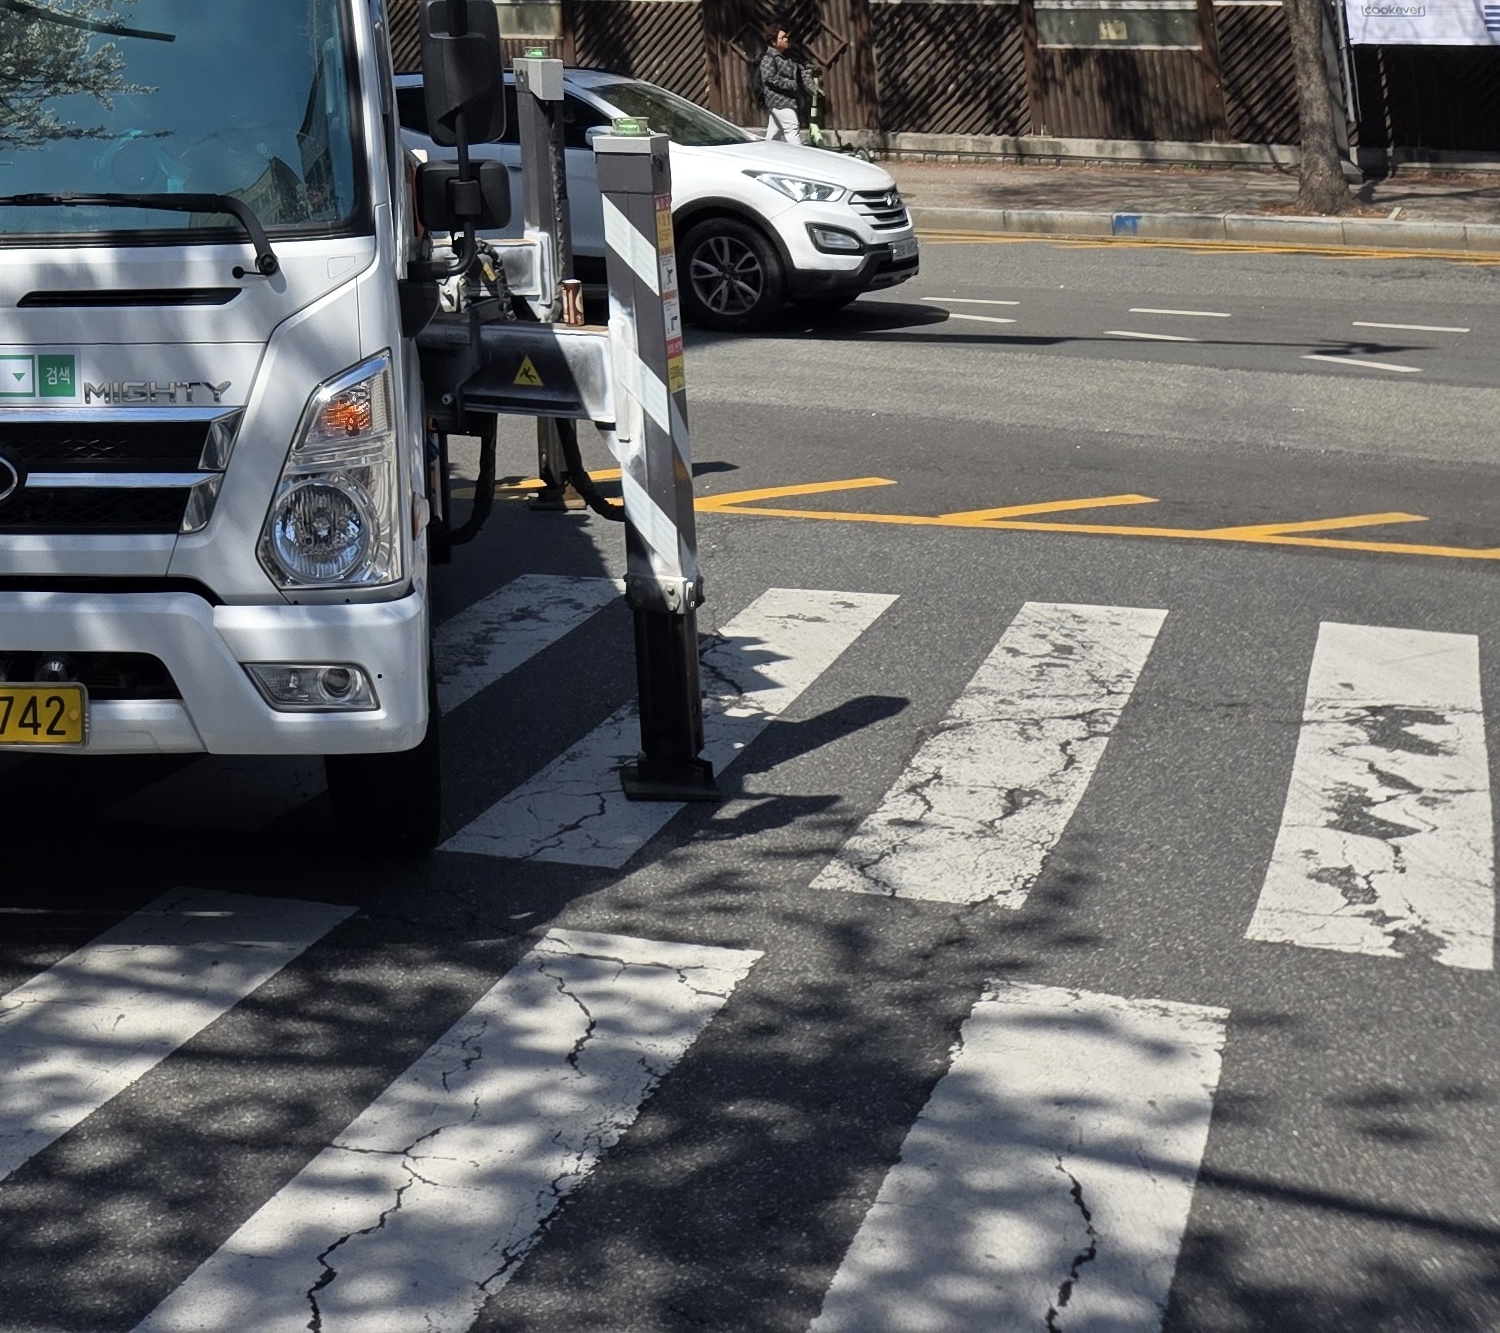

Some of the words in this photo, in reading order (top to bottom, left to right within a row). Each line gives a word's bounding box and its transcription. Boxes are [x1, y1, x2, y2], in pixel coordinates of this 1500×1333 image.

[1365, 5, 1422, 15] cookever
[45, 366, 72, 386] 검색
[83, 380, 232, 404] MIGHTY
